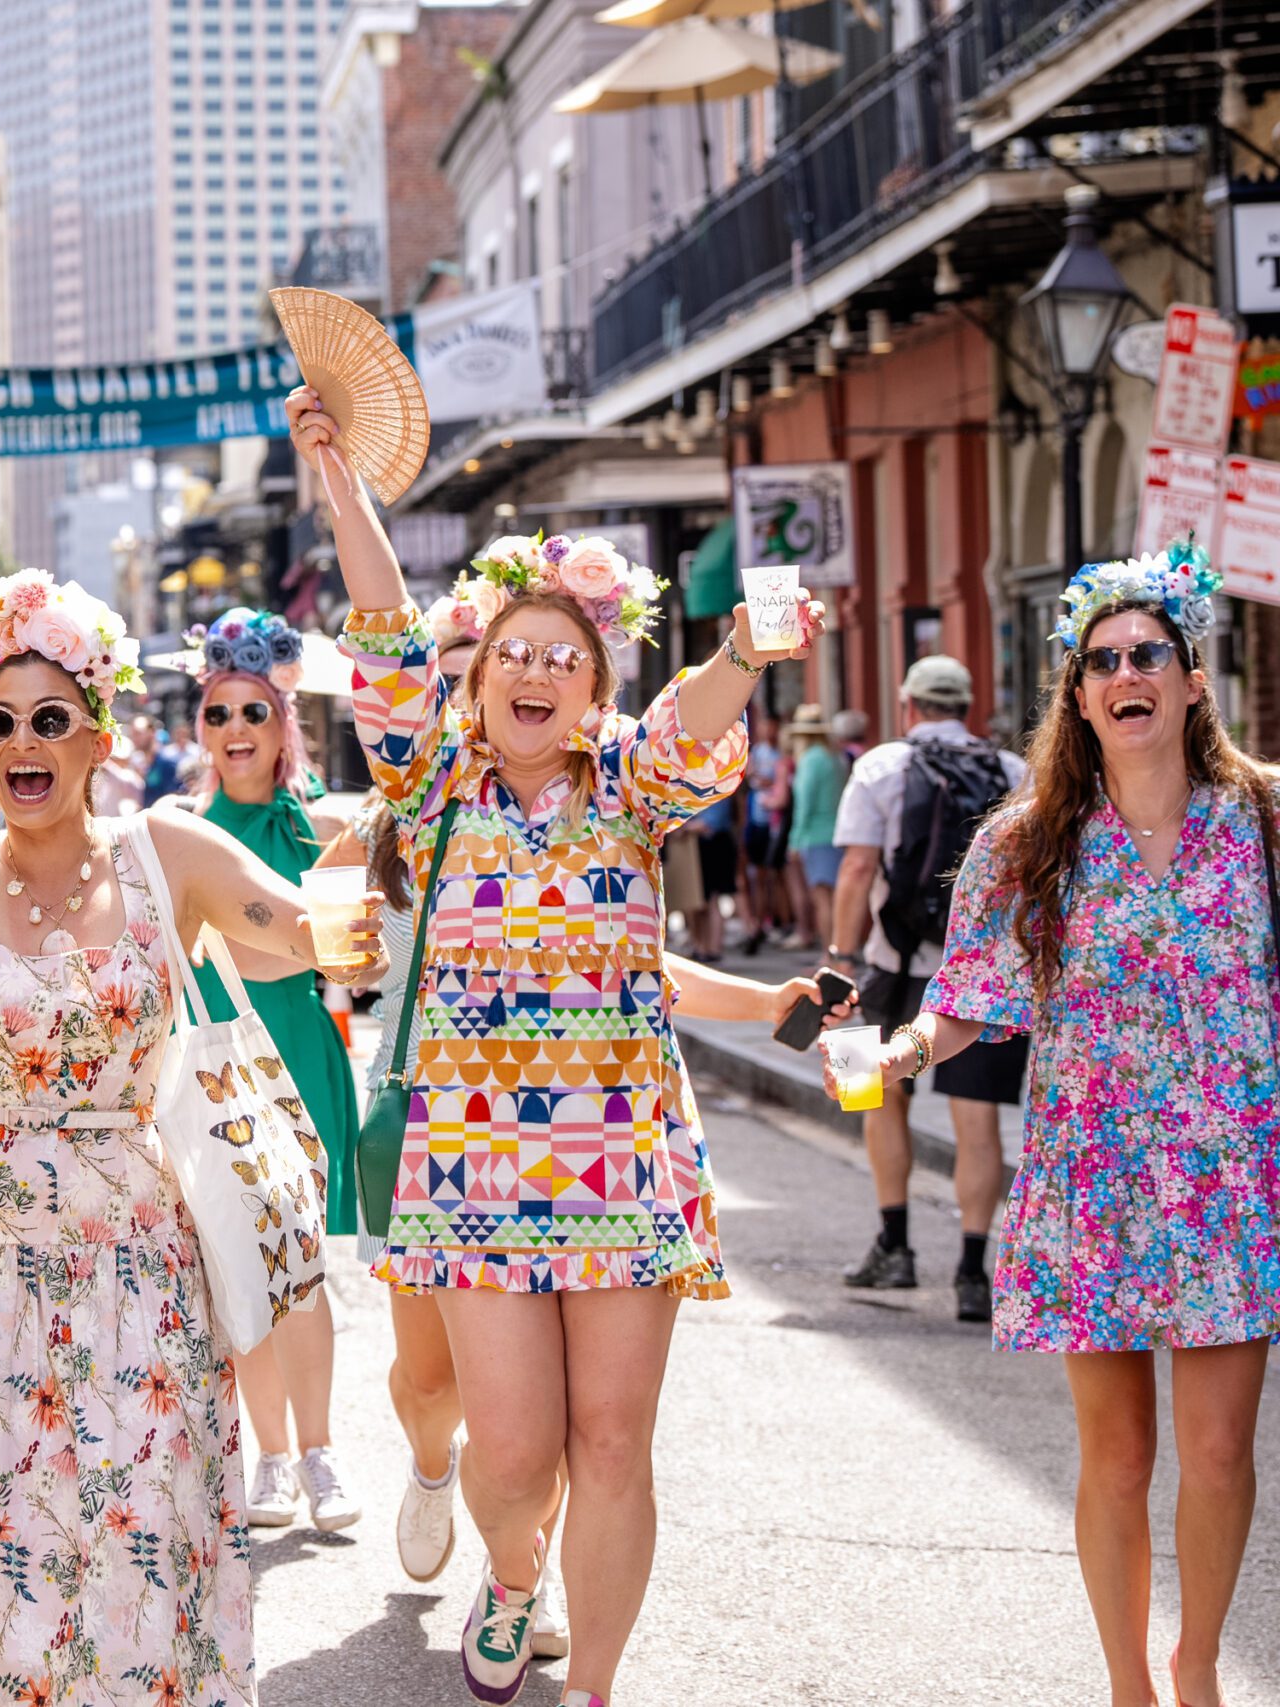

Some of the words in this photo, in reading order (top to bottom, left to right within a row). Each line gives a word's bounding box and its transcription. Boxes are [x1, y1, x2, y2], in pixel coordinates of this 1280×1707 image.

[53, 359, 218, 410] QUARTER
[237, 349, 300, 391] FES
[197, 401, 258, 441] APRIL
[830, 1055, 850, 1069] RLY
